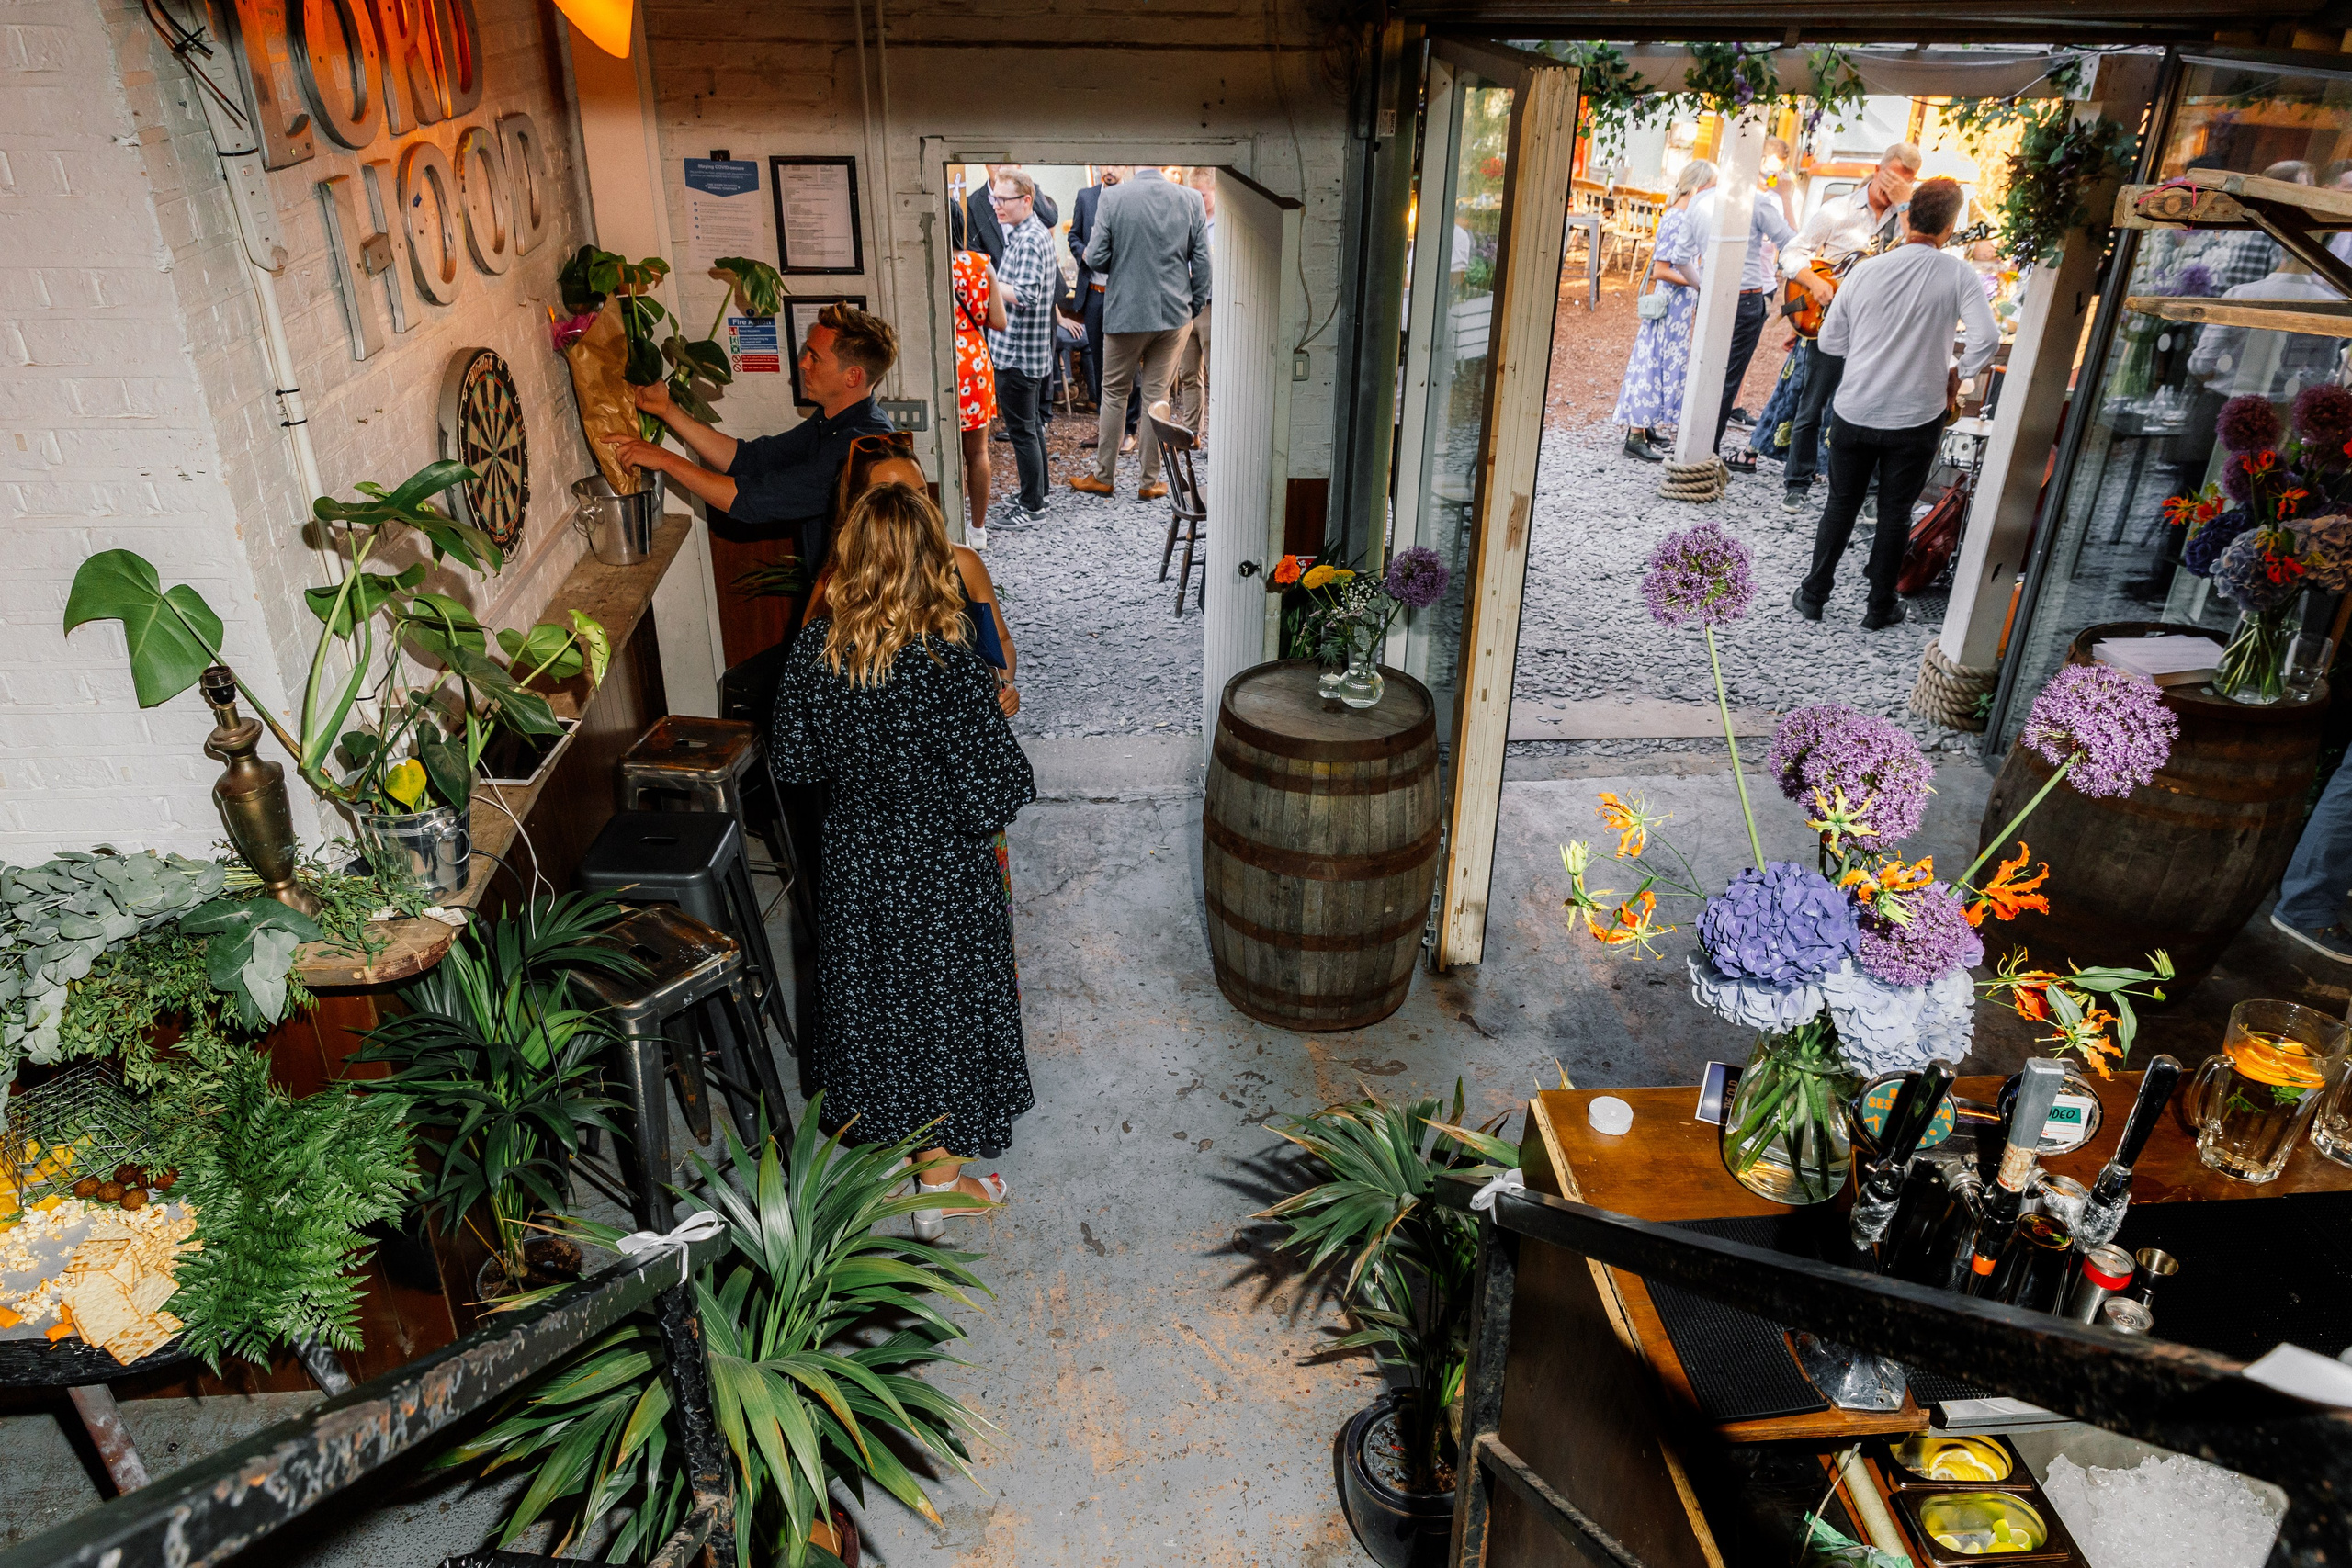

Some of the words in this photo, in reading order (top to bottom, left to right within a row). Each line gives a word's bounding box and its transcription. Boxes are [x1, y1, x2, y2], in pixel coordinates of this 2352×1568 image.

[208, 0, 482, 172] LORD
[318, 112, 549, 361] HOOD
[1725, 1079, 1738, 1096] OLD
[1867, 1096, 1894, 1111] SES
[2048, 1108, 2075, 1119] DEO
